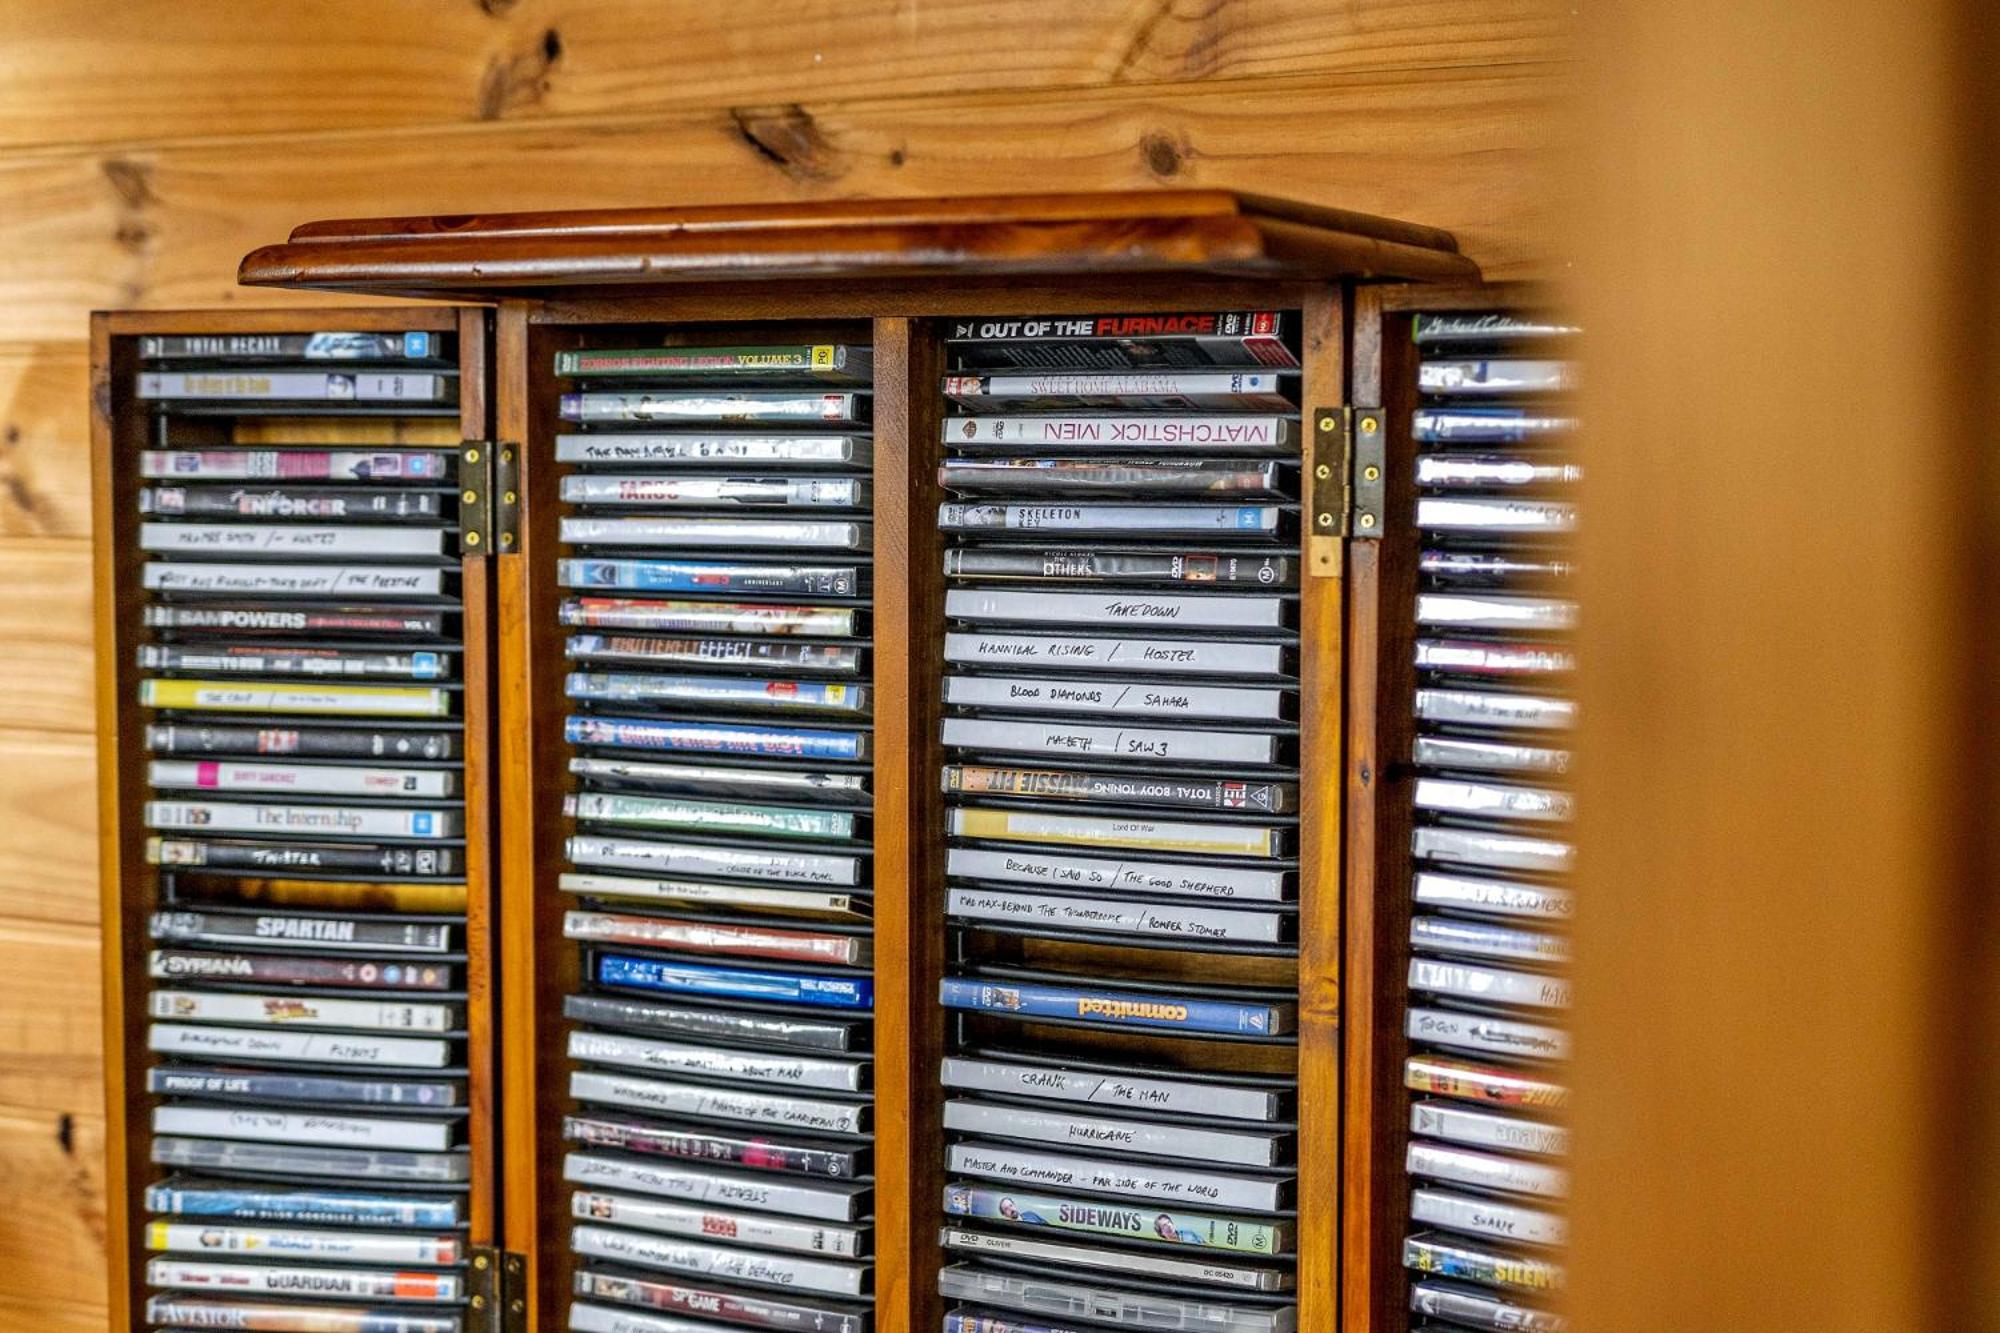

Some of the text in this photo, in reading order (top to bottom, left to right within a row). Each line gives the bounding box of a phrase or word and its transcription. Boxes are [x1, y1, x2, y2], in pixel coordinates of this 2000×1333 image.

[980, 315, 1214, 339] OUT OF THE FURNACE
[738, 355, 791, 366] VOLUME
[792, 354, 802, 364] 3
[818, 351, 827, 365] PG
[1075, 379, 1114, 394] HOME
[1116, 379, 1179, 394] ALABAMA
[1045, 423, 1268, 443] MATCHSTICK MEN
[239, 496, 346, 515] ENFORCER
[1018, 508, 1081, 528] SKELETON KEY
[1043, 562, 1092, 577] OTHERS
[979, 642, 1038, 656] HANNIBAL
[1048, 643, 1095, 657] RISING
[1144, 647, 1195, 663] HOSTEL
[1010, 684, 1040, 698] BLOOD
[1050, 688, 1102, 702] DIAMONDS
[1145, 693, 1189, 709] SAHARA
[1046, 734, 1092, 751] MACBETH
[1128, 740, 1154, 752] SAW
[1156, 742, 1169, 757] 3
[987, 771, 1018, 792] FIT
[1094, 782, 1138, 796] TONING
[1140, 784, 1172, 798] BODY
[1175, 786, 1213, 800] TOTAL
[255, 807, 363, 833] The Internship
[1112, 823, 1128, 832] Lord
[1140, 824, 1155, 833] War
[1005, 859, 1049, 877] BECAUSE
[1060, 870, 1081, 882] SAID
[1089, 871, 1103, 882] SO
[1124, 871, 1145, 883] THE
[1149, 876, 1172, 889] GOOD
[1180, 879, 1234, 896] SHEPHERD
[1038, 904, 1058, 917] THE
[1149, 916, 1183, 932] ROMPER
[256, 917, 355, 940] SPARTAN
[168, 955, 253, 975] SYRIANA
[1078, 998, 1187, 1020] committed
[165, 1076, 251, 1092] PROOF OF LIFE
[1022, 1073, 1066, 1090] CRANK
[1112, 1084, 1133, 1099] THE
[1140, 1089, 1170, 1103] MAN
[1069, 1124, 1136, 1142] HURRICANE
[963, 1157, 1218, 1198] MASTER AND COMMANDER FAR SIDE OF THE WORLD
[1059, 1204, 1142, 1231] SIDEWAYS
[960, 1234, 979, 1243] DVD
[266, 1274, 351, 1291] GUARDIAN
